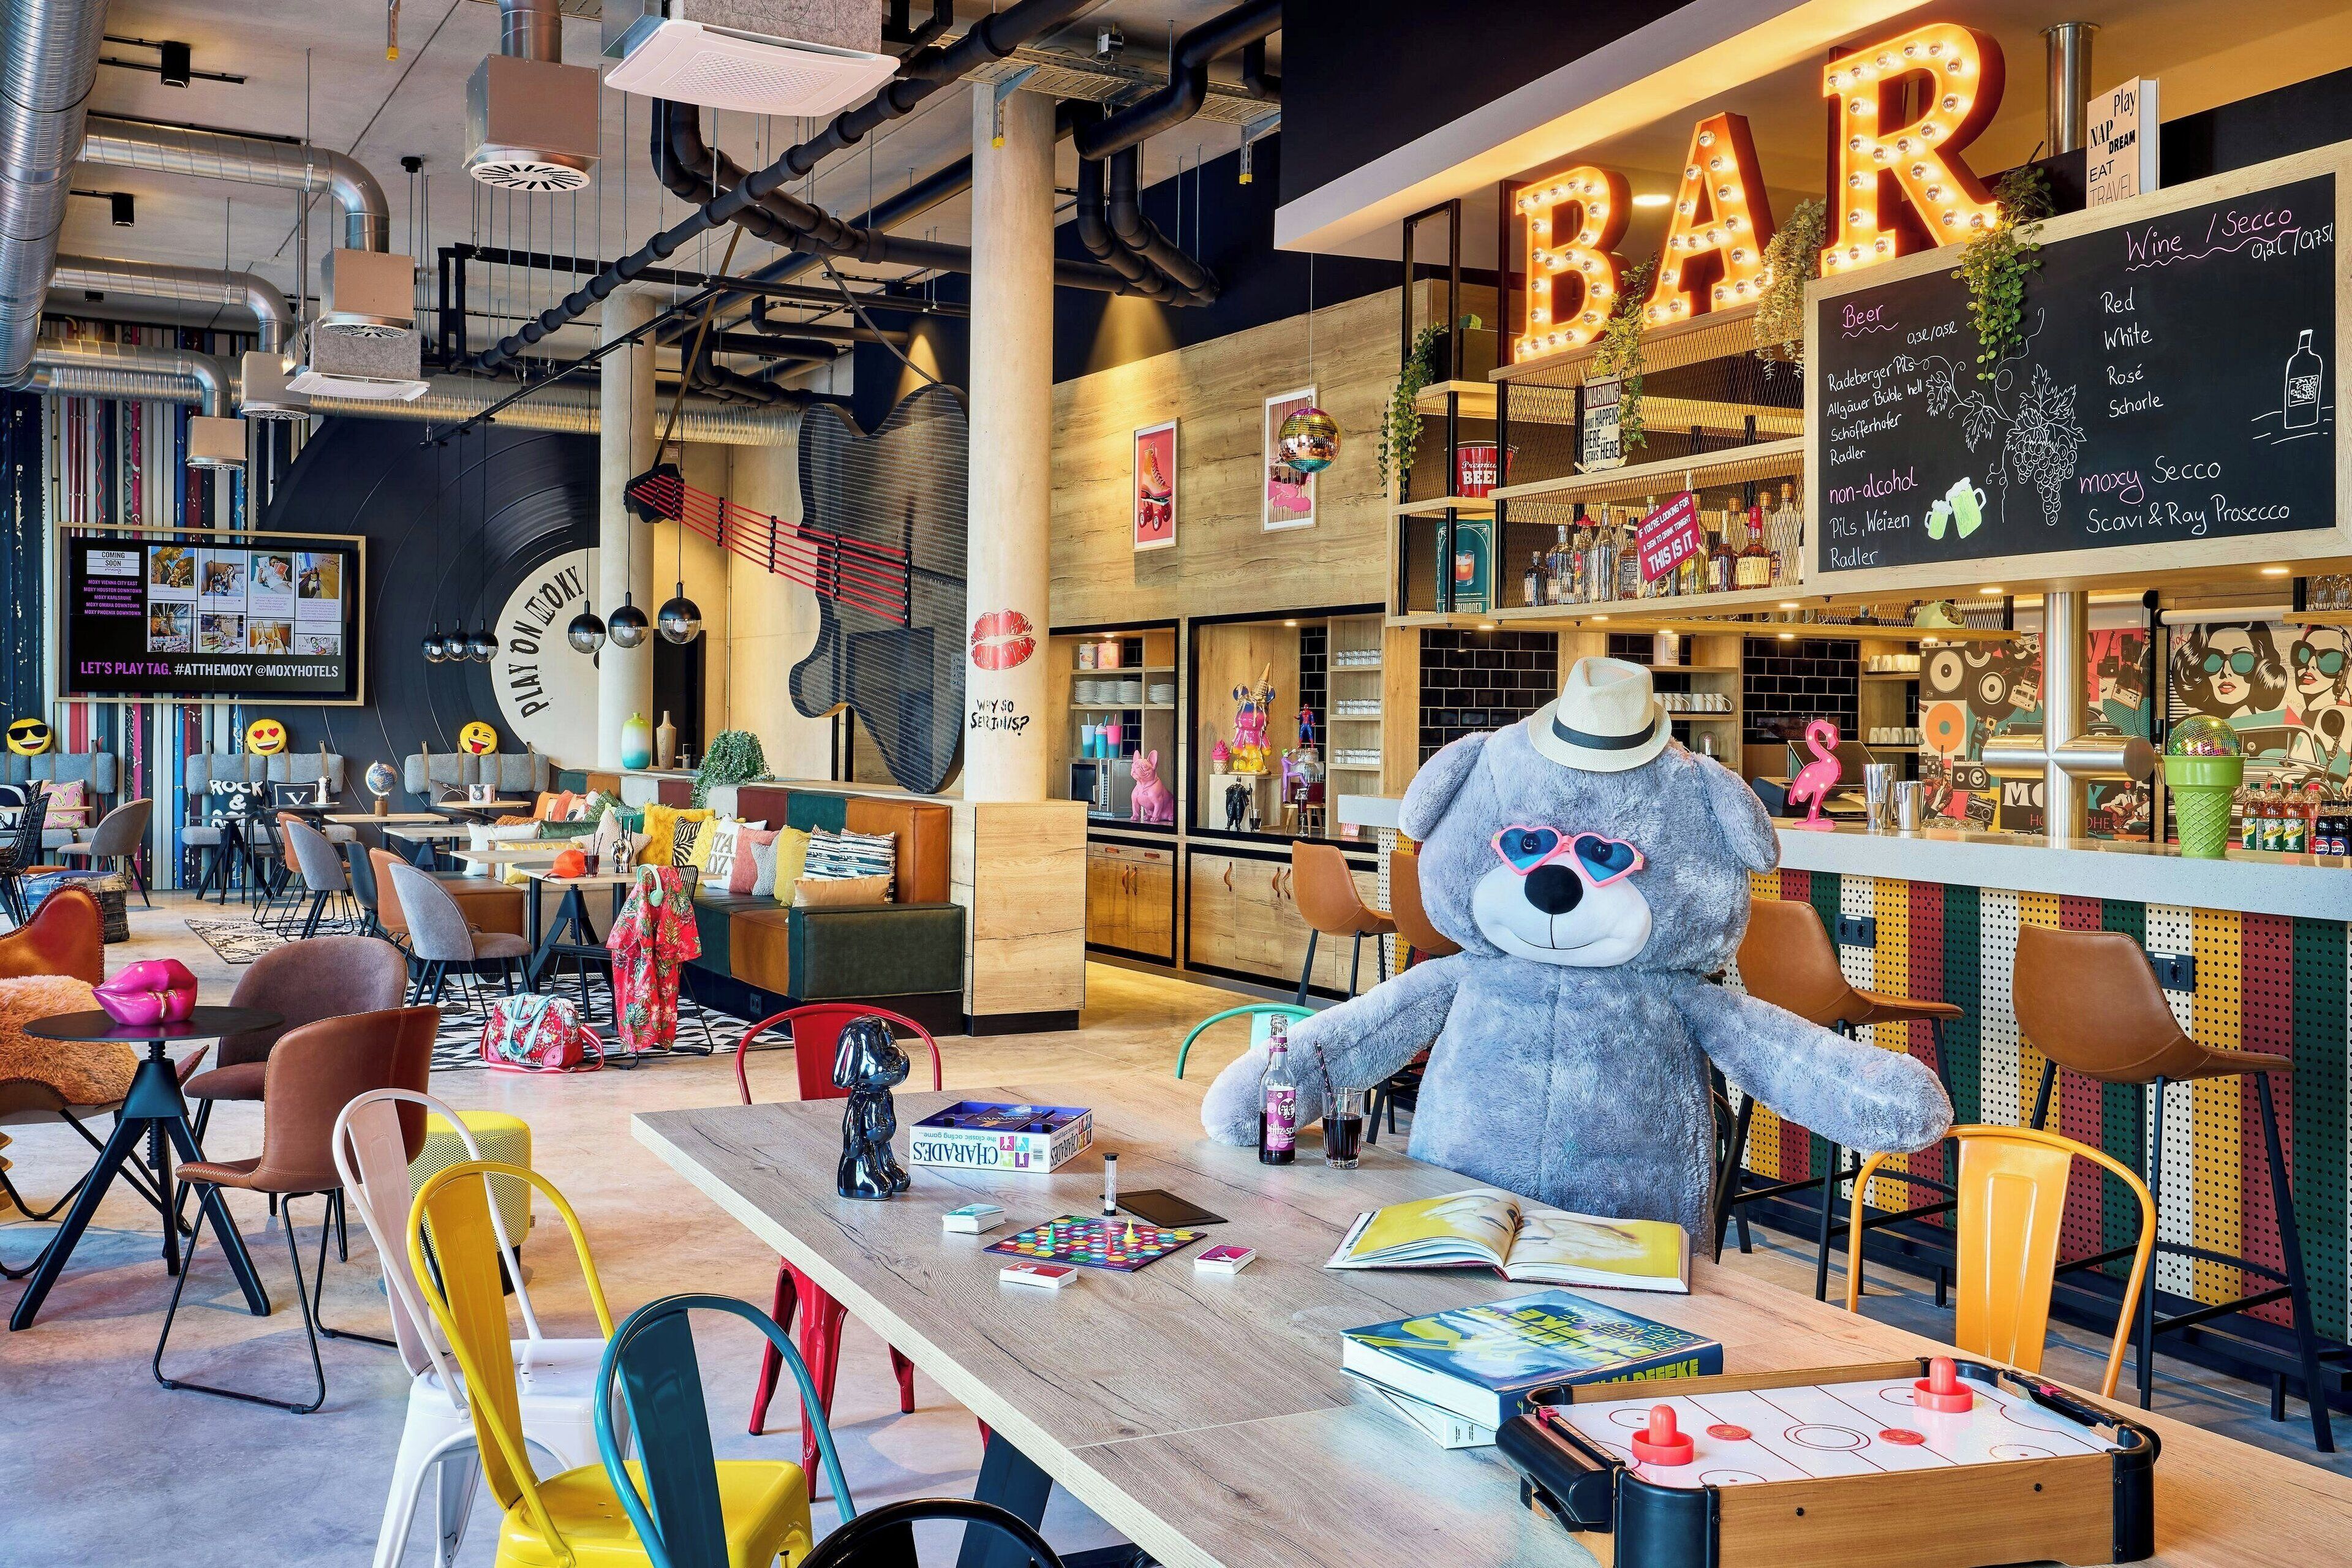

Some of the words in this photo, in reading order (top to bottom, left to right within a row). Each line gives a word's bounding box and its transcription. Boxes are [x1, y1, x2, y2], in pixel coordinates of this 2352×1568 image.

[2114, 88, 2136, 117] Play
[2090, 119, 2114, 149] NAP
[2109, 129, 2136, 155] DREAM
[2090, 159, 2114, 183] EAT
[1513, 21, 2006, 368] BAR
[2089, 173, 2136, 208] TRAVEL
[2127, 226, 2182, 261] Wine
[2222, 209, 2291, 236] Secco
[2101, 287, 2135, 313] Red
[1843, 304, 1883, 328] Beer
[2105, 322, 2152, 350] White
[1828, 363, 1893, 391] Radeberger
[1893, 356, 1914, 374] Pils
[2107, 364, 2143, 385] Rosé
[1586, 382, 1619, 408] WARNING
[1827, 398, 1870, 419] Allgäuer
[1907, 379, 1922, 395] hell
[2109, 391, 2163, 417] Schorle
[1585, 418, 1594, 429] WHAT
[1595, 406, 1619, 428] HAPPENS
[1831, 412, 1902, 441] Schöfferhofer
[1586, 450, 1599, 462] STAYS
[1600, 440, 1619, 459] HERE
[1830, 446, 1866, 466] Radler
[1461, 461, 1496, 469] Premiu
[1830, 466, 1918, 504] non-alcohol
[2079, 470, 2144, 504] moxy
[2152, 456, 2221, 483] Secco
[1638, 529, 1644, 539] IF
[1660, 504, 1679, 523] LOOKING
[1679, 496, 1690, 510] FOR
[1867, 510, 1909, 531] Weizen
[2086, 505, 2143, 533] Scavi
[2149, 502, 2163, 526] &
[2165, 502, 2207, 535] Ray
[2211, 494, 2289, 522] Prosecco
[1643, 545, 1647, 553] A
[1646, 538, 1656, 550] SIGN
[1656, 534, 1663, 543] TO
[1662, 526, 1675, 540] DRINK
[1675, 514, 1691, 532] TONIGHT
[1647, 545, 1672, 575] THIS
[1671, 538, 1683, 560] IS
[1683, 529, 1693, 552] IT
[1831, 547, 1878, 568] Radler
[524, 566, 584, 626] MOXY
[510, 620, 543, 654] ON
[81, 662, 112, 674] LET'S
[115, 662, 144, 674] PLAY
[146, 663, 172, 675] TAG.
[174, 663, 253, 676] #ATTHEMOXY
[255, 665, 339, 677] @MOXYHOTELS
[508, 663, 549, 718] PLAY
[977, 699, 998, 713] WHY
[1001, 699, 1014, 712] SO
[209, 780, 263, 796] ROCK
[2002, 782, 2107, 810] MY
[229, 794, 246, 810] &
[712, 832, 733, 854] TA
[913, 1142, 998, 1165] CHARADES
[1050, 1133, 1078, 1166] CHARADES
[1562, 1314, 1590, 1324] OF
[1588, 1322, 1674, 1351] PIONEER
[1644, 1333, 1687, 1348] THE
[1647, 1324, 1707, 1344] LOGO
